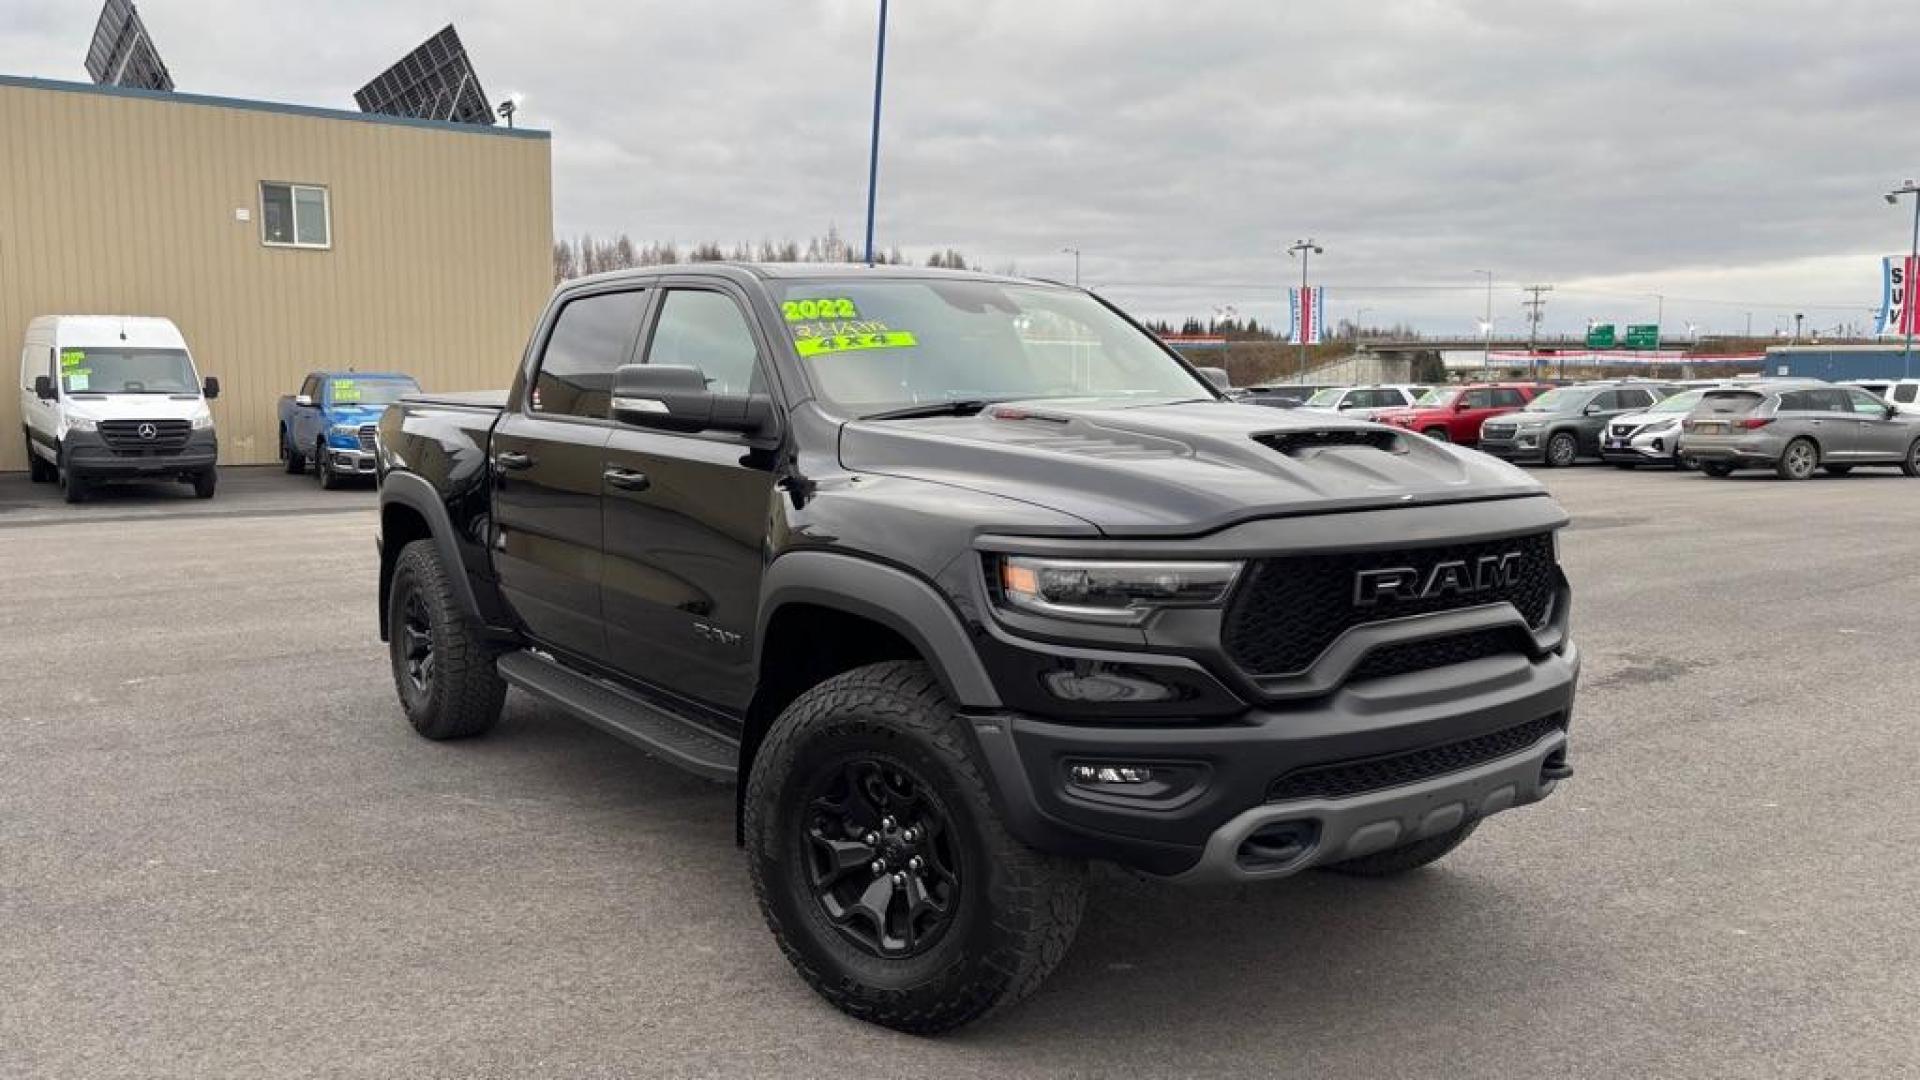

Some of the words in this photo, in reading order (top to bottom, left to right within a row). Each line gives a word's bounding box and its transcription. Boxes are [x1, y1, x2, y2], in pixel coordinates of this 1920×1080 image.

[782, 298, 856, 321] 2022
[1890, 267, 1903, 324] SUV
[1353, 551, 1522, 606] RAM
